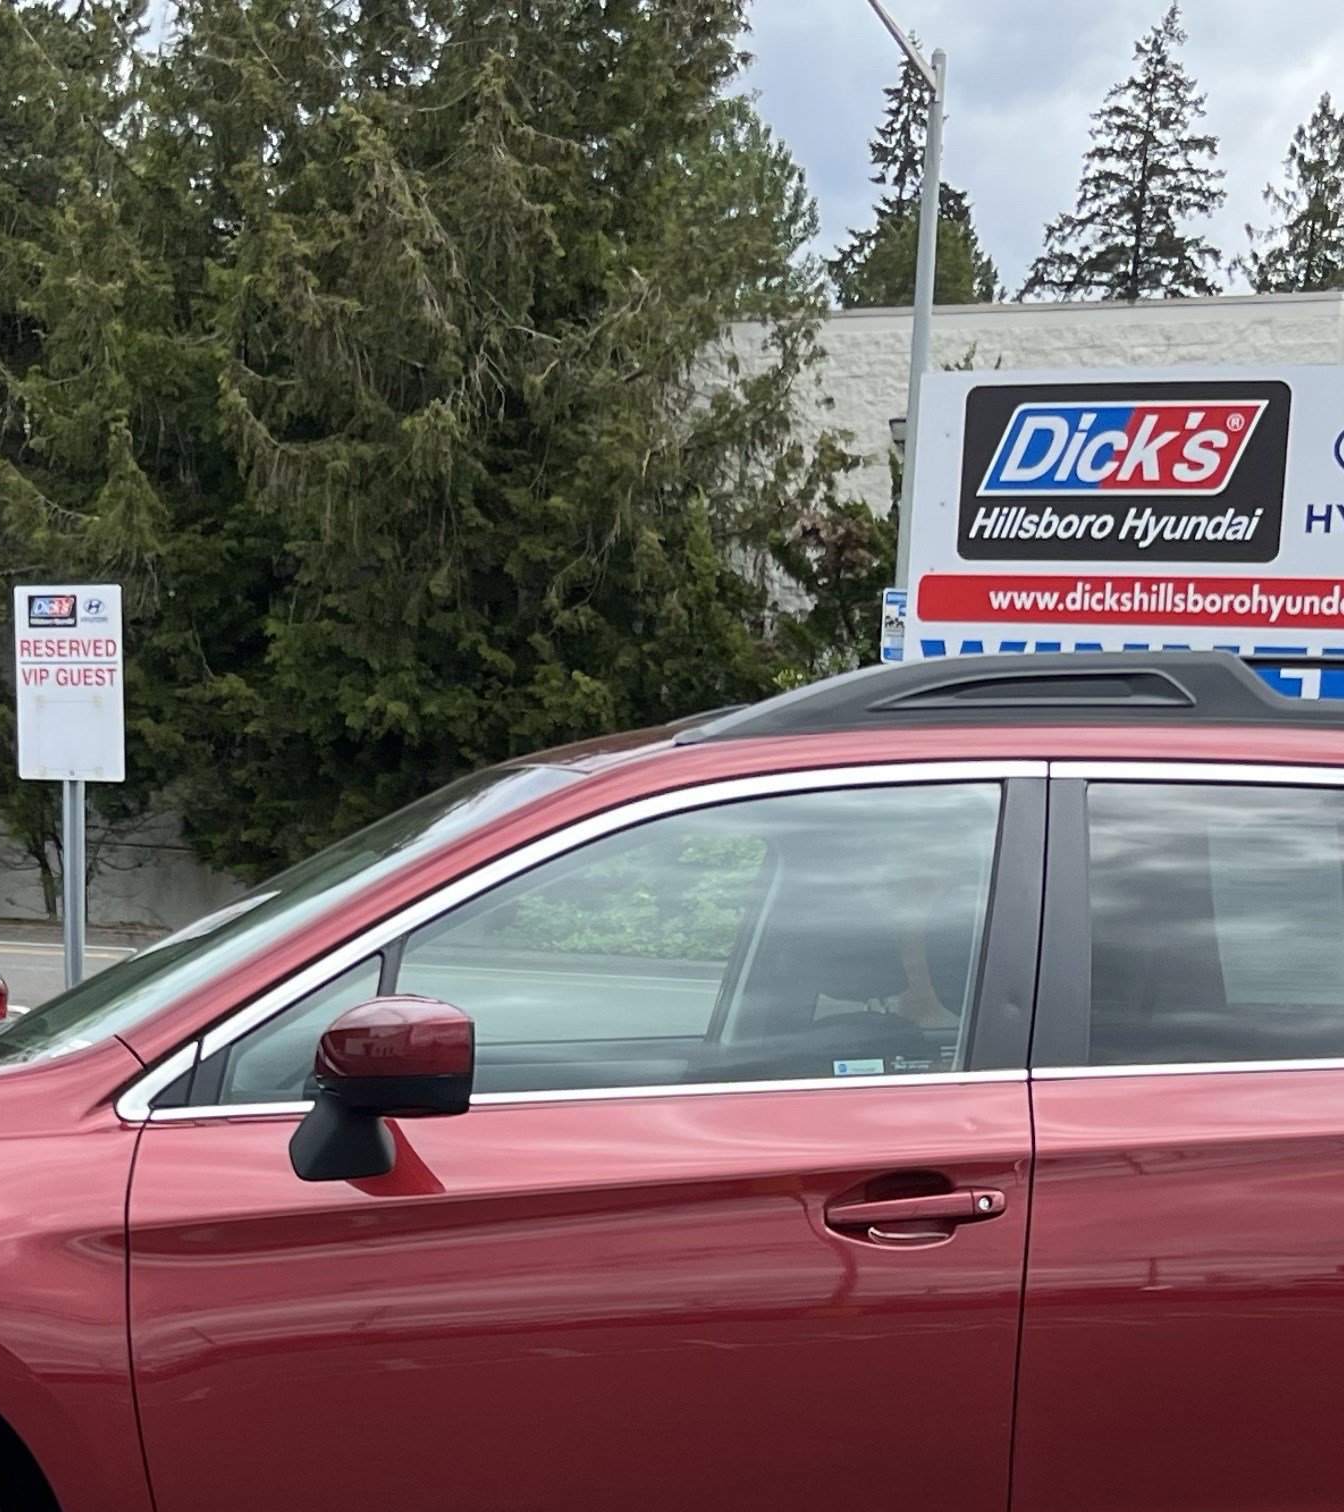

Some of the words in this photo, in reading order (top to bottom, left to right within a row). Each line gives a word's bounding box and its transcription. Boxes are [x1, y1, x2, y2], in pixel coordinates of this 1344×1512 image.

[968, 507, 1115, 541] Hillsboro
[1118, 507, 1264, 549] Hyundai
[20, 639, 117, 657] RESERVED
[21, 667, 49, 686] VIP
[56, 667, 117, 687] GUEST
